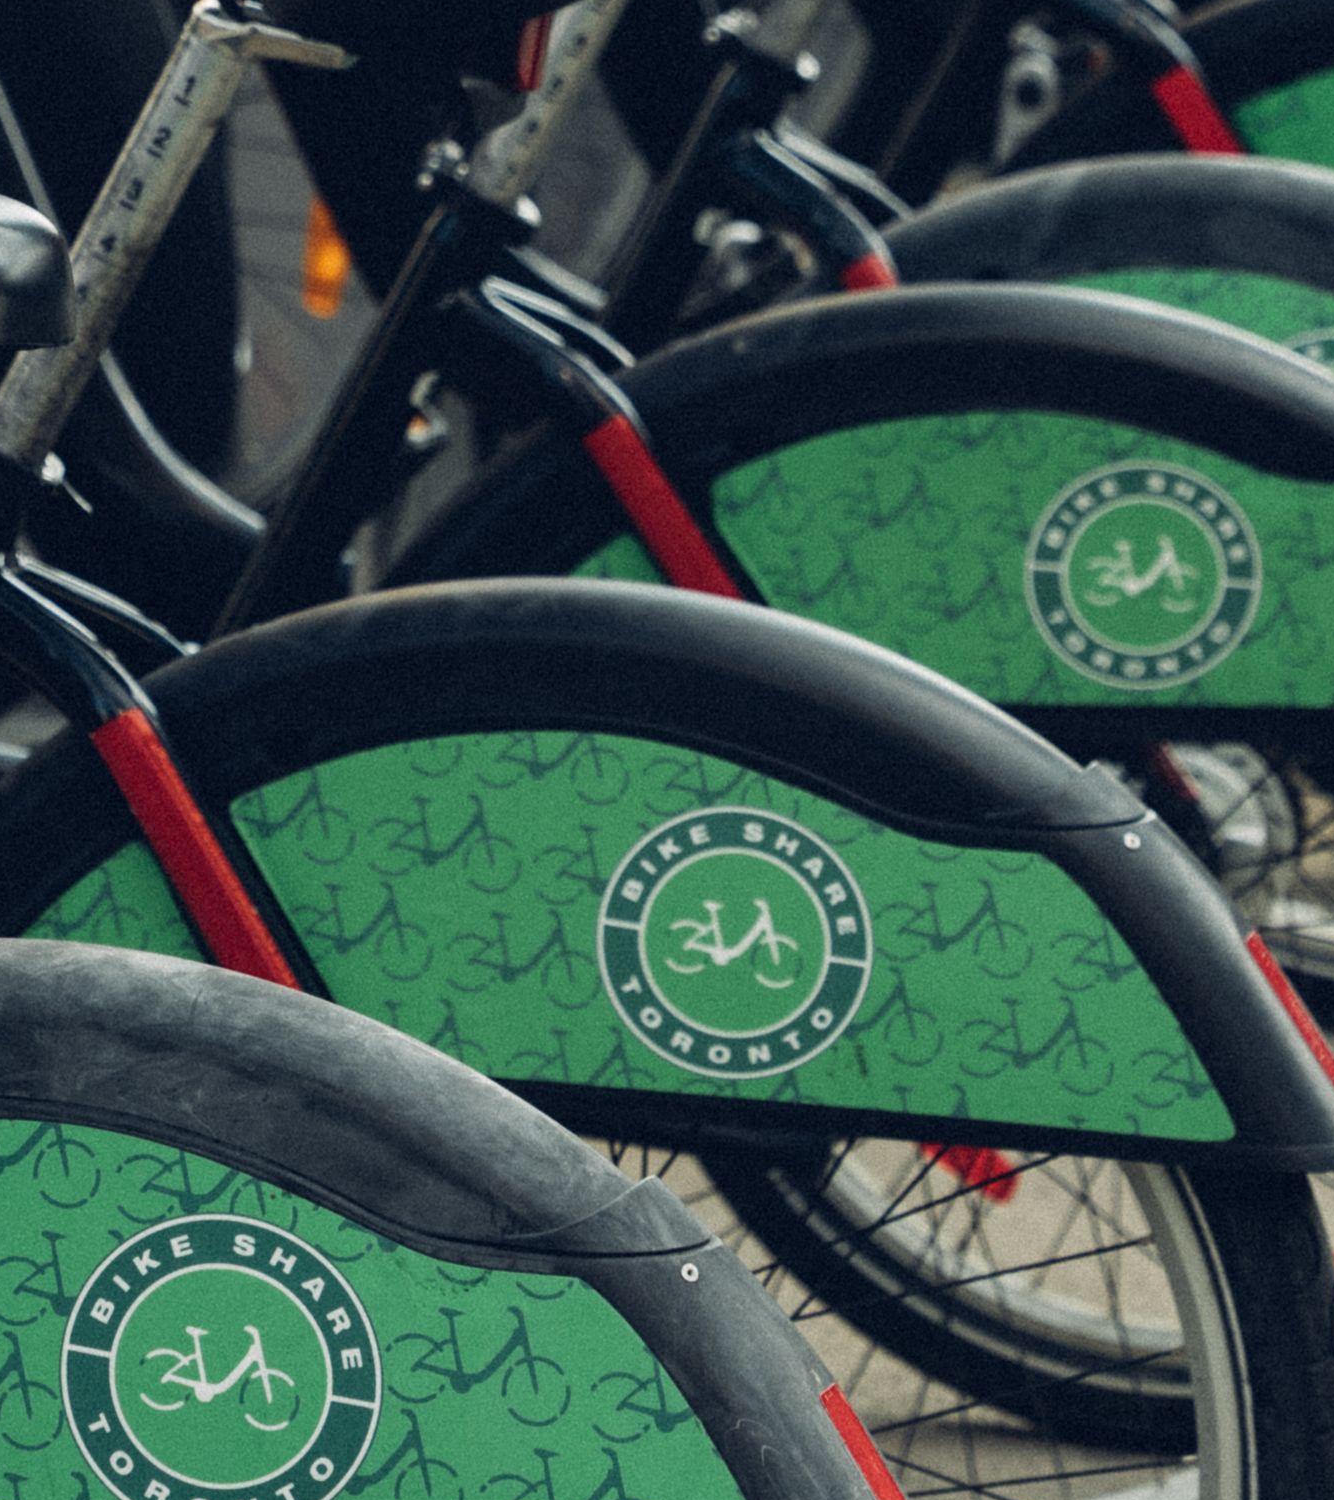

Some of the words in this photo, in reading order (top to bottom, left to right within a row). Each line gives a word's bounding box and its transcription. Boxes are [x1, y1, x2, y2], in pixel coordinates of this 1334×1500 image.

[620, 822, 711, 903] BIKE
[742, 821, 857, 937] SHARE
[620, 974, 834, 1065] TORONTO
[89, 1233, 194, 1325] BIKE
[232, 1233, 364, 1371] SHARE
